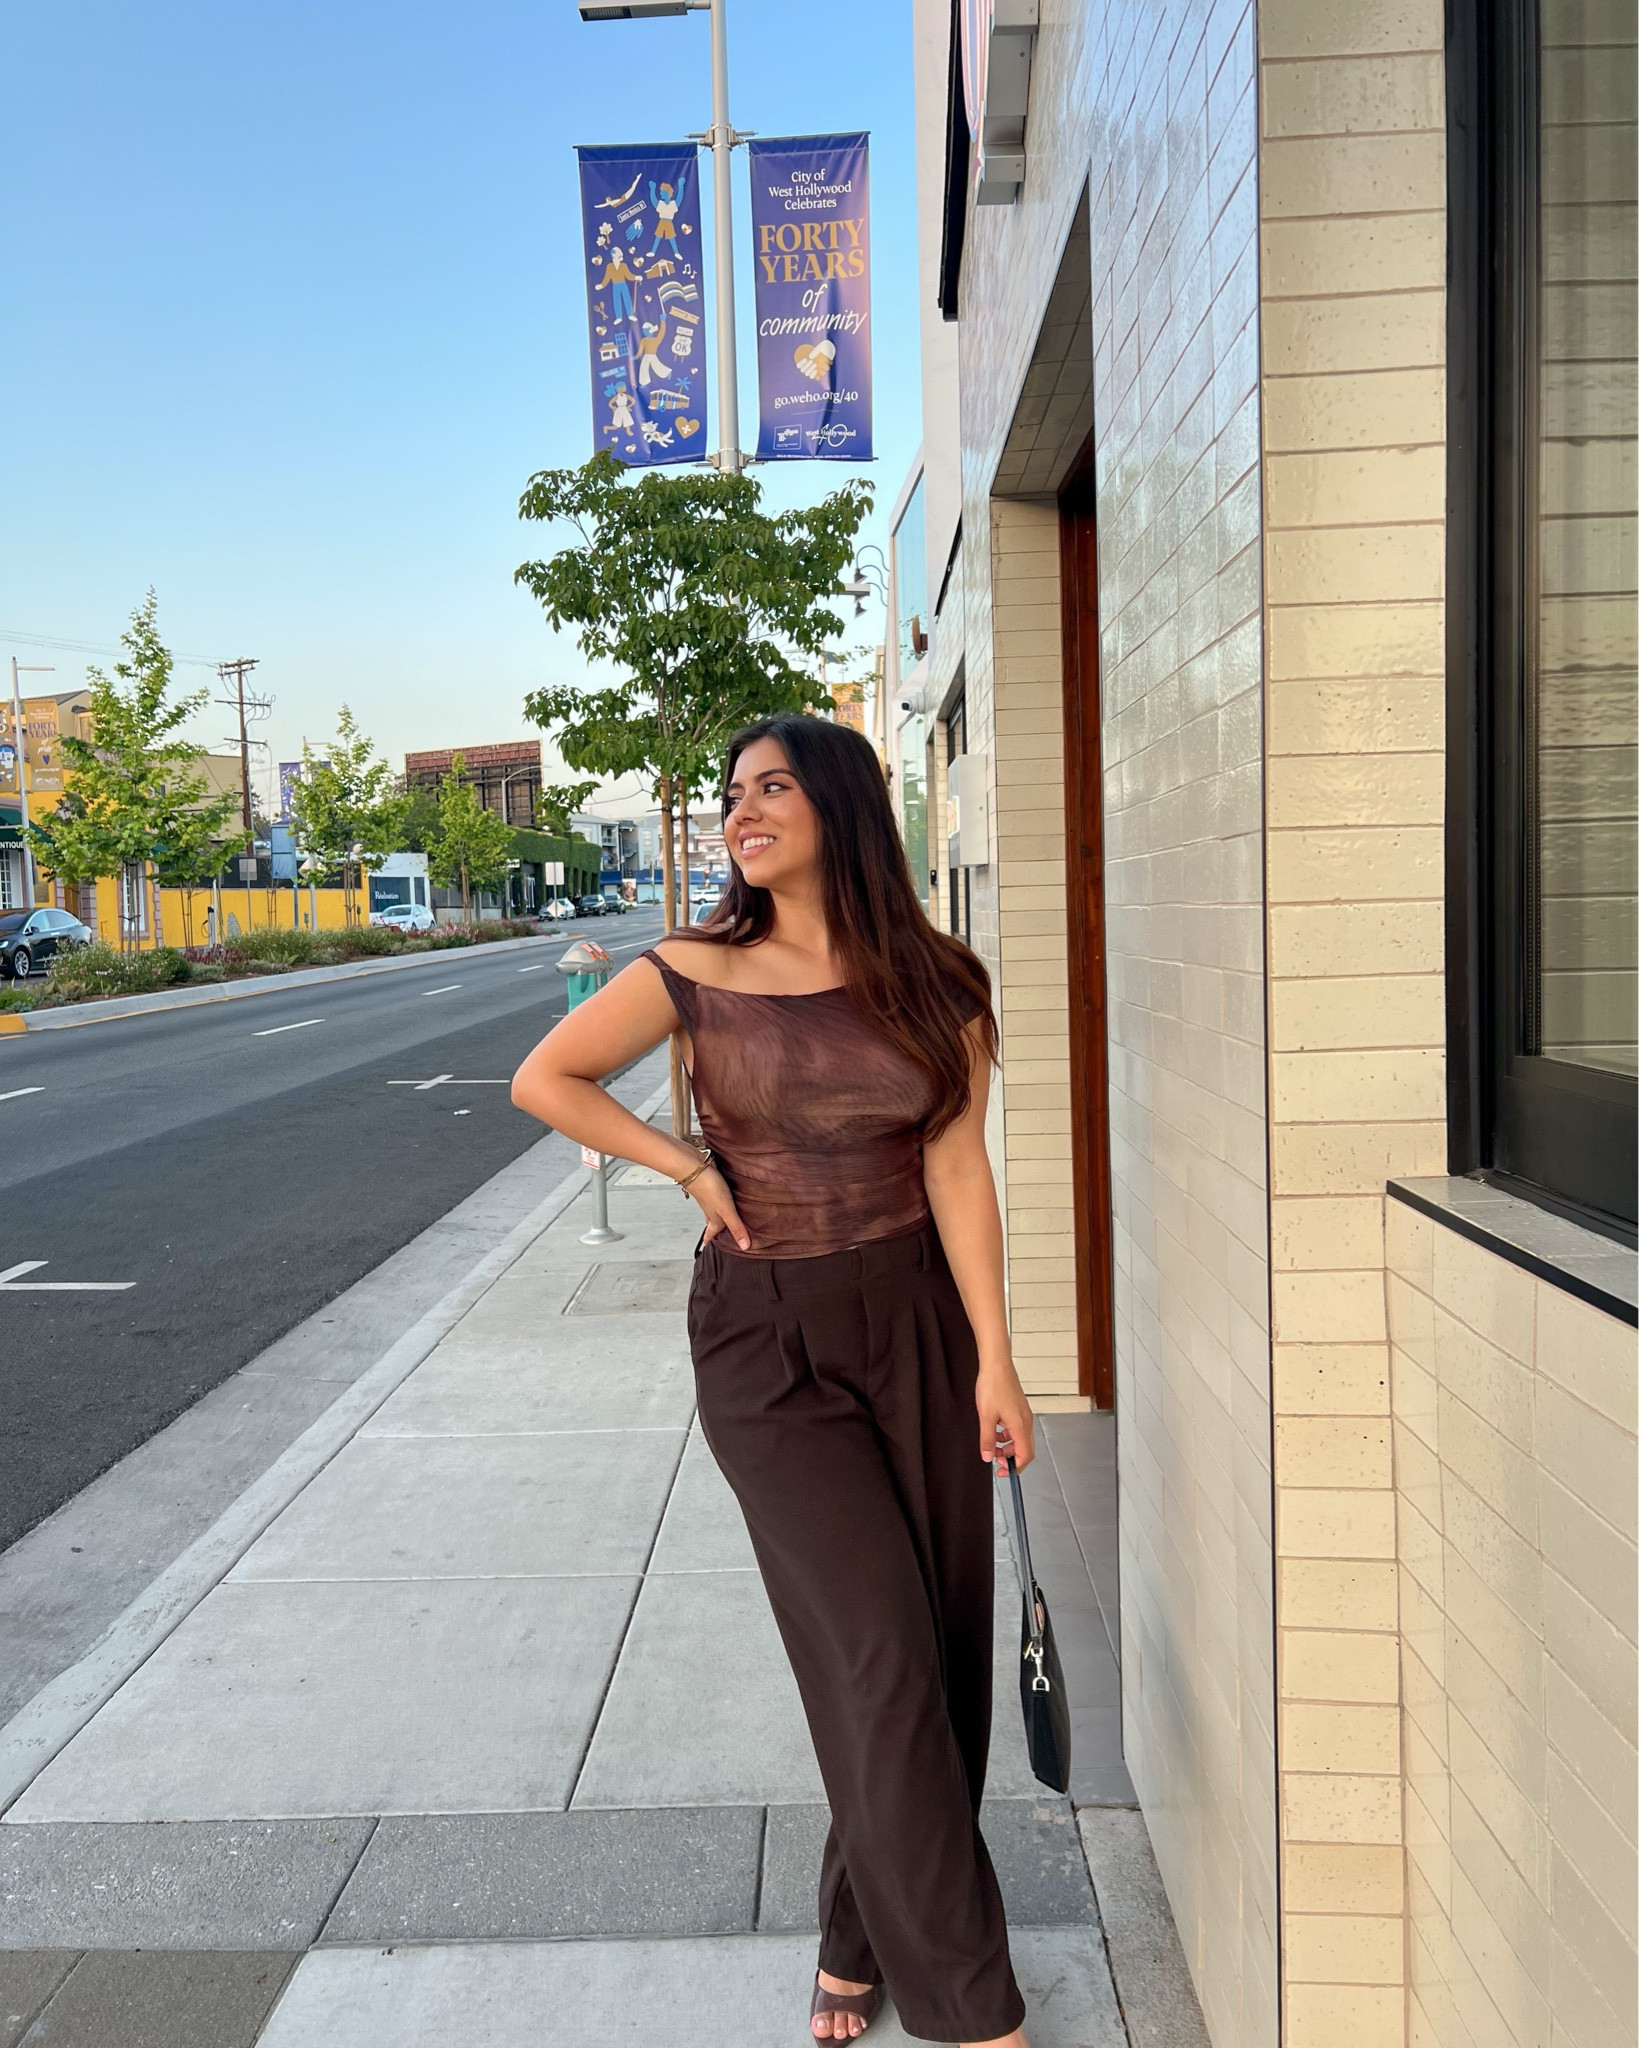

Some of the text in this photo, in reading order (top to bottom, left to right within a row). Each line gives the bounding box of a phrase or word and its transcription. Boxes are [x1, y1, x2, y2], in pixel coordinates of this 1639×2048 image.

[791, 168, 826, 184] City of
[768, 180, 852, 198] West Hollywood
[784, 197, 837, 210] Celebrates
[758, 218, 865, 253] FORTY
[758, 249, 865, 283] YEARS
[802, 283, 829, 313] of
[759, 309, 868, 337] community
[675, 342, 688, 353] OK
[774, 388, 859, 409] go.weho.org/40
[28, 721, 57, 731] FORTY
